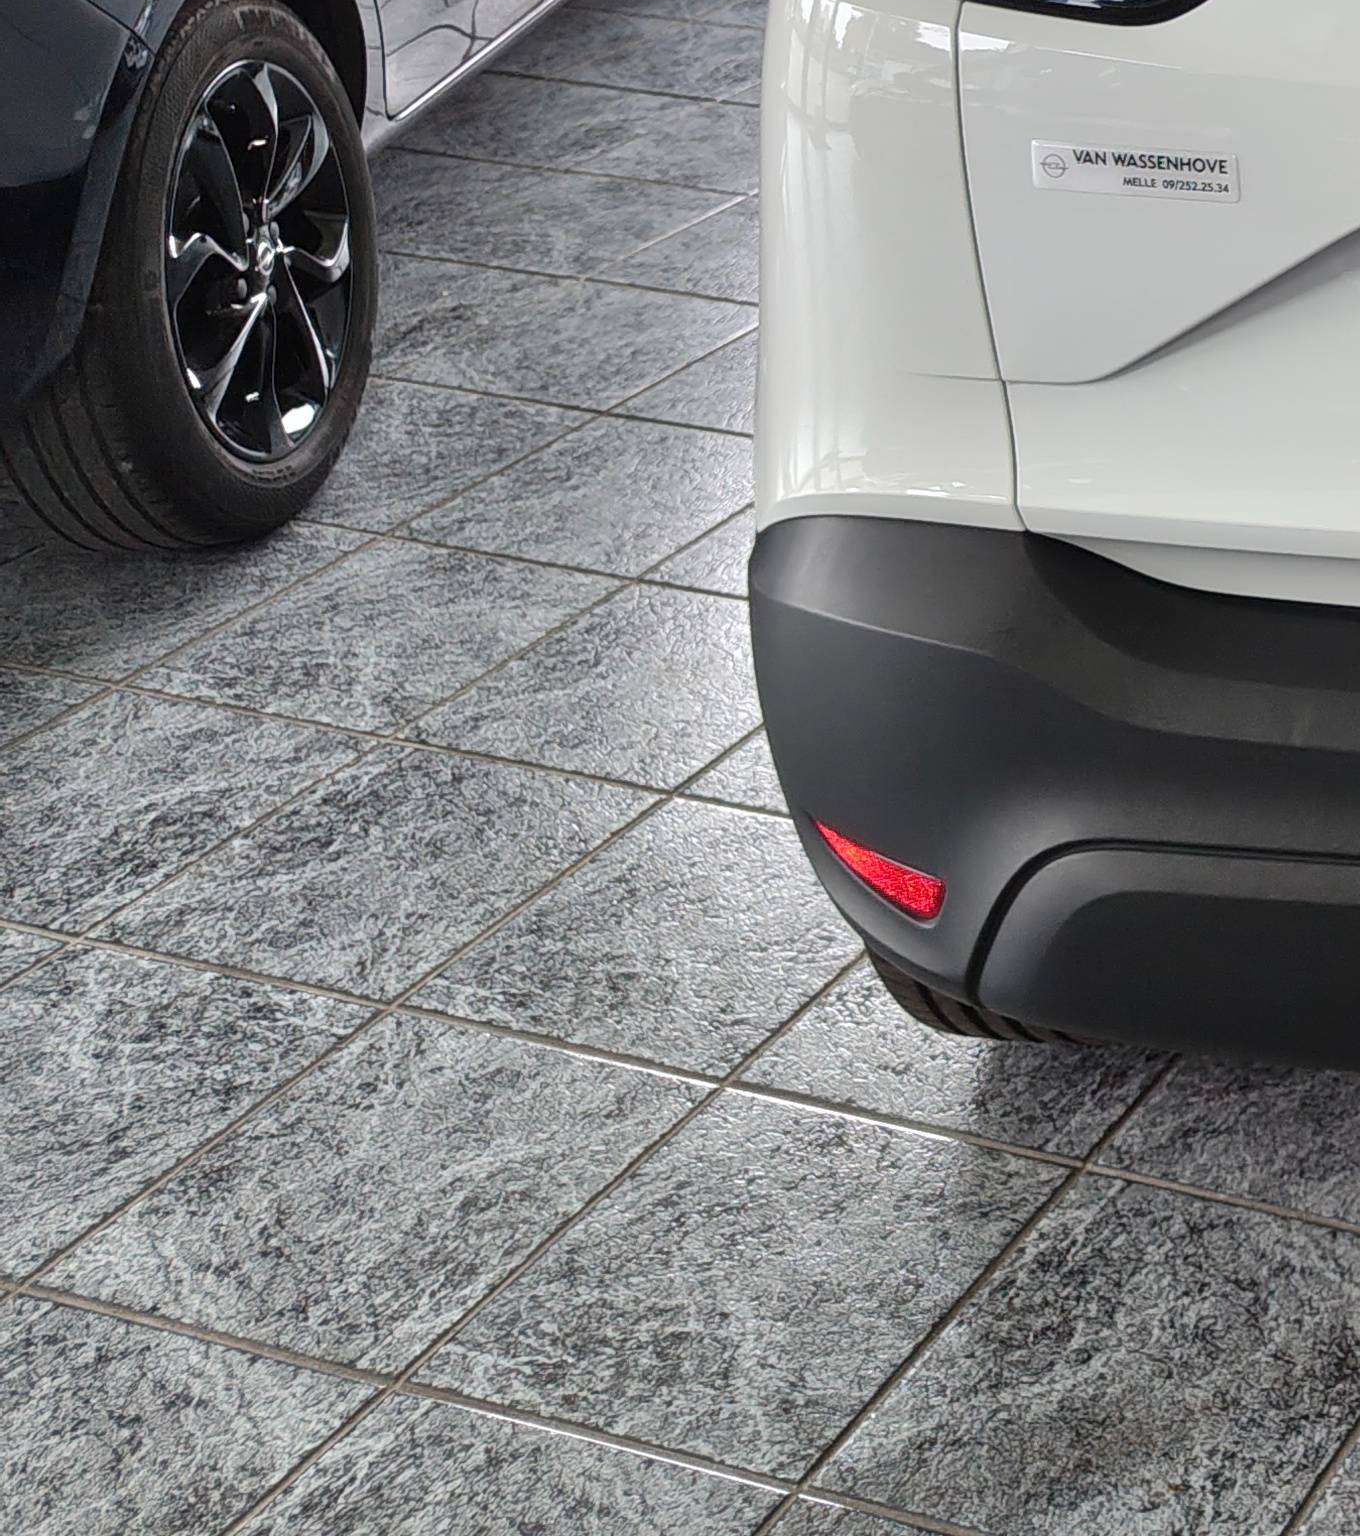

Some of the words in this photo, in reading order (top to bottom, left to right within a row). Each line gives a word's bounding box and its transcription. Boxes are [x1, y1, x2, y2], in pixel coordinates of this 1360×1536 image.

[1072, 148, 1108, 166] VAN
[1111, 151, 1229, 175] WASSENHOVE
[1122, 176, 1158, 189] MELLE
[1161, 179, 1230, 194] 09/252.25.34
